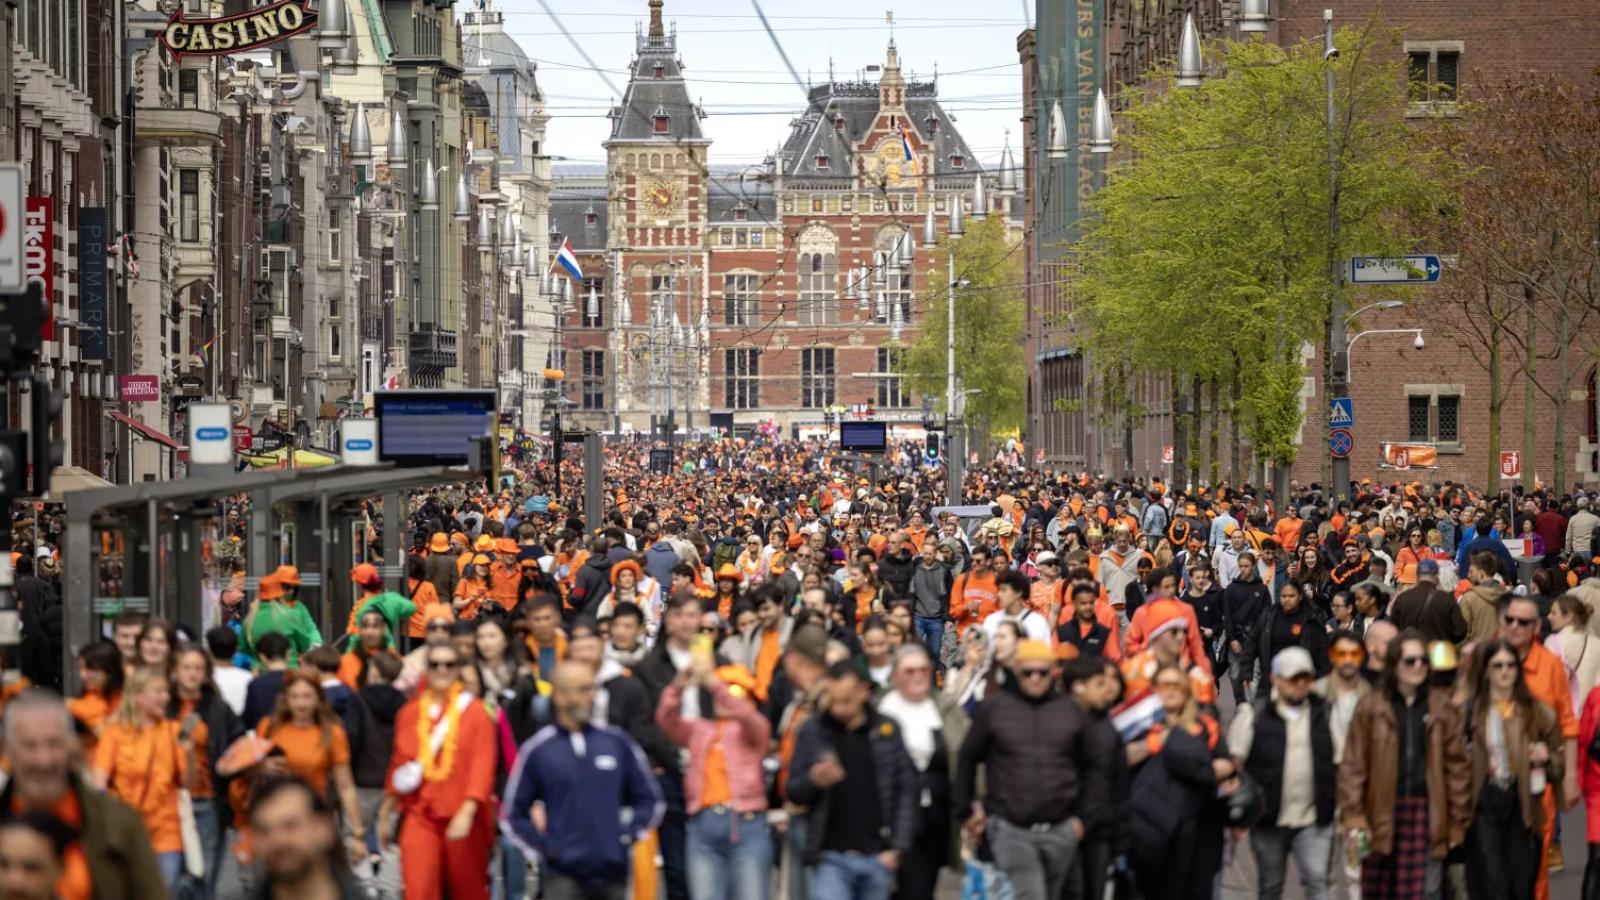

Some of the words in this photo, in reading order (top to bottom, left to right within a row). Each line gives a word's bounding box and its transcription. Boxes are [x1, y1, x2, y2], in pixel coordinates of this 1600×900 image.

[165, 3, 303, 50] CASINO
[1077, 48, 1094, 96] VAN
[85, 225, 102, 341] PRIMARK
